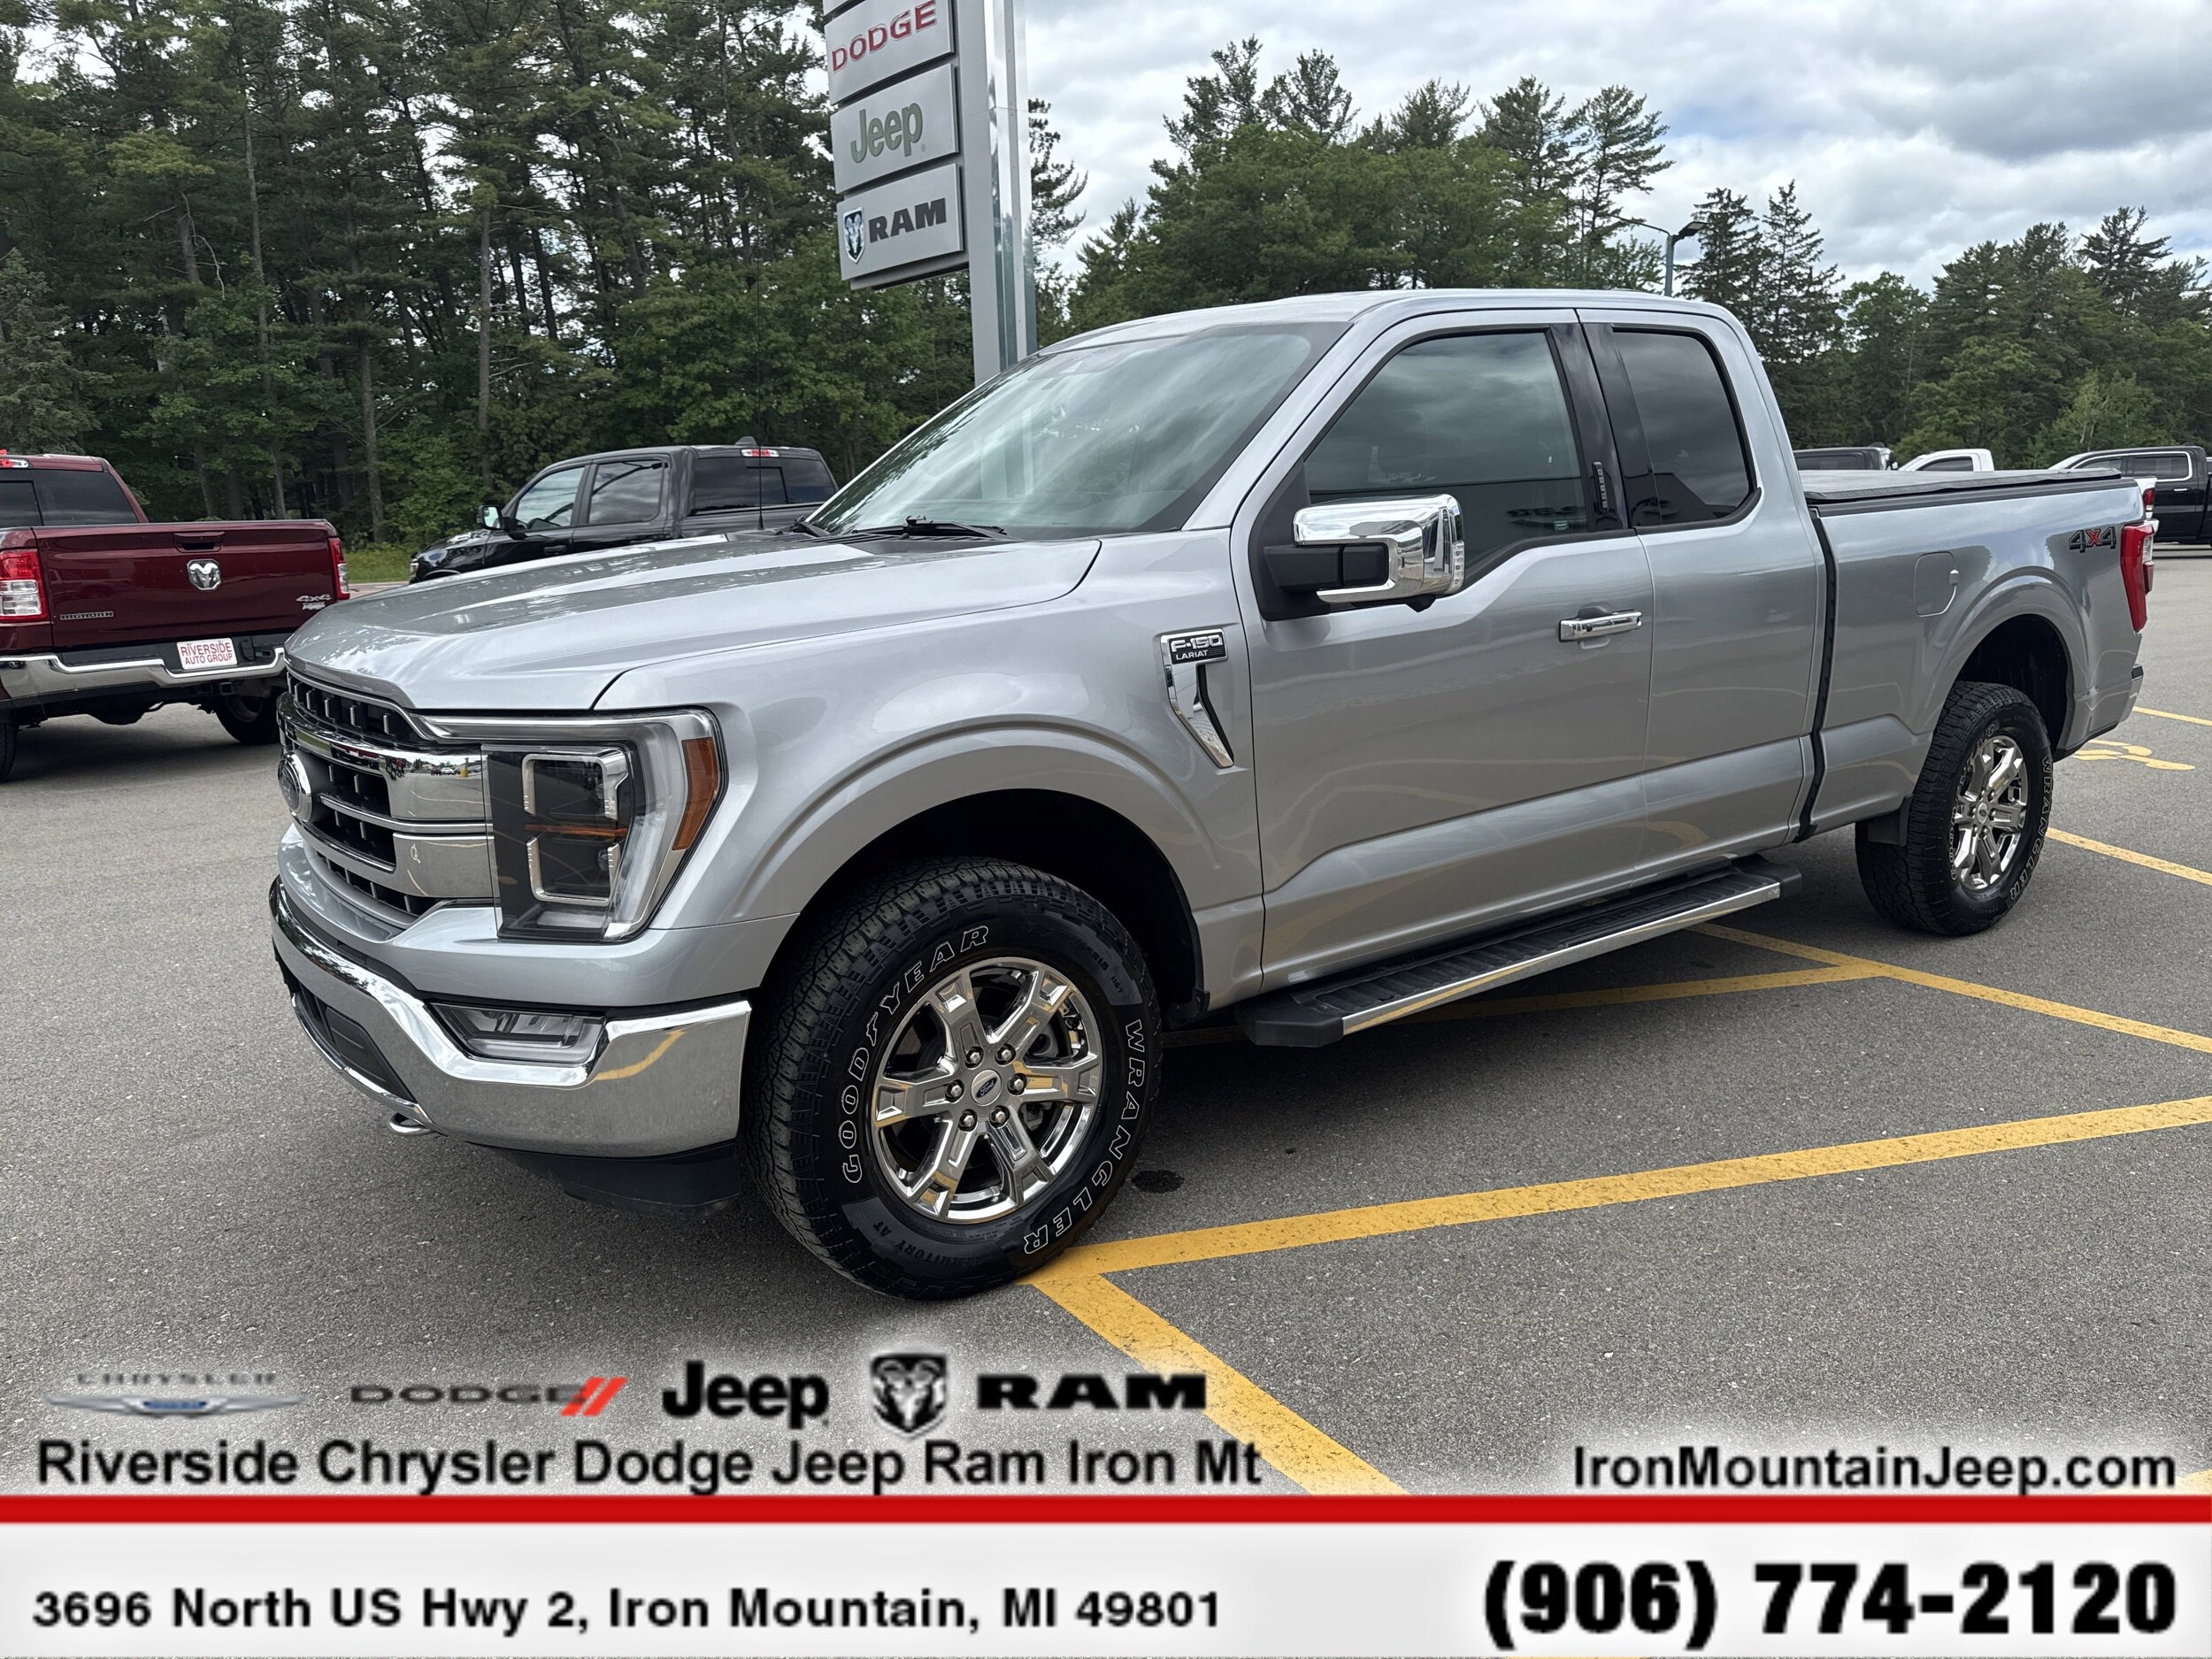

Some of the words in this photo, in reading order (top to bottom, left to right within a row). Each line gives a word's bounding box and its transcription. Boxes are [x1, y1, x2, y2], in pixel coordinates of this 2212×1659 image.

[832, 1, 938, 73] DODGE
[850, 103, 924, 163] Jeep
[868, 197, 947, 243] RAM
[180, 642, 233, 657] RIVERSIDE
[185, 655, 205, 664] AUTO
[207, 653, 233, 663] GROUP
[1171, 635, 1223, 652] F-150
[1176, 650, 1209, 660] LARIAT
[2010, 755, 2053, 901] WRANGLER
[839, 926, 989, 1184] GOODYEAR
[1023, 1019, 1145, 1255] WRANGLER
